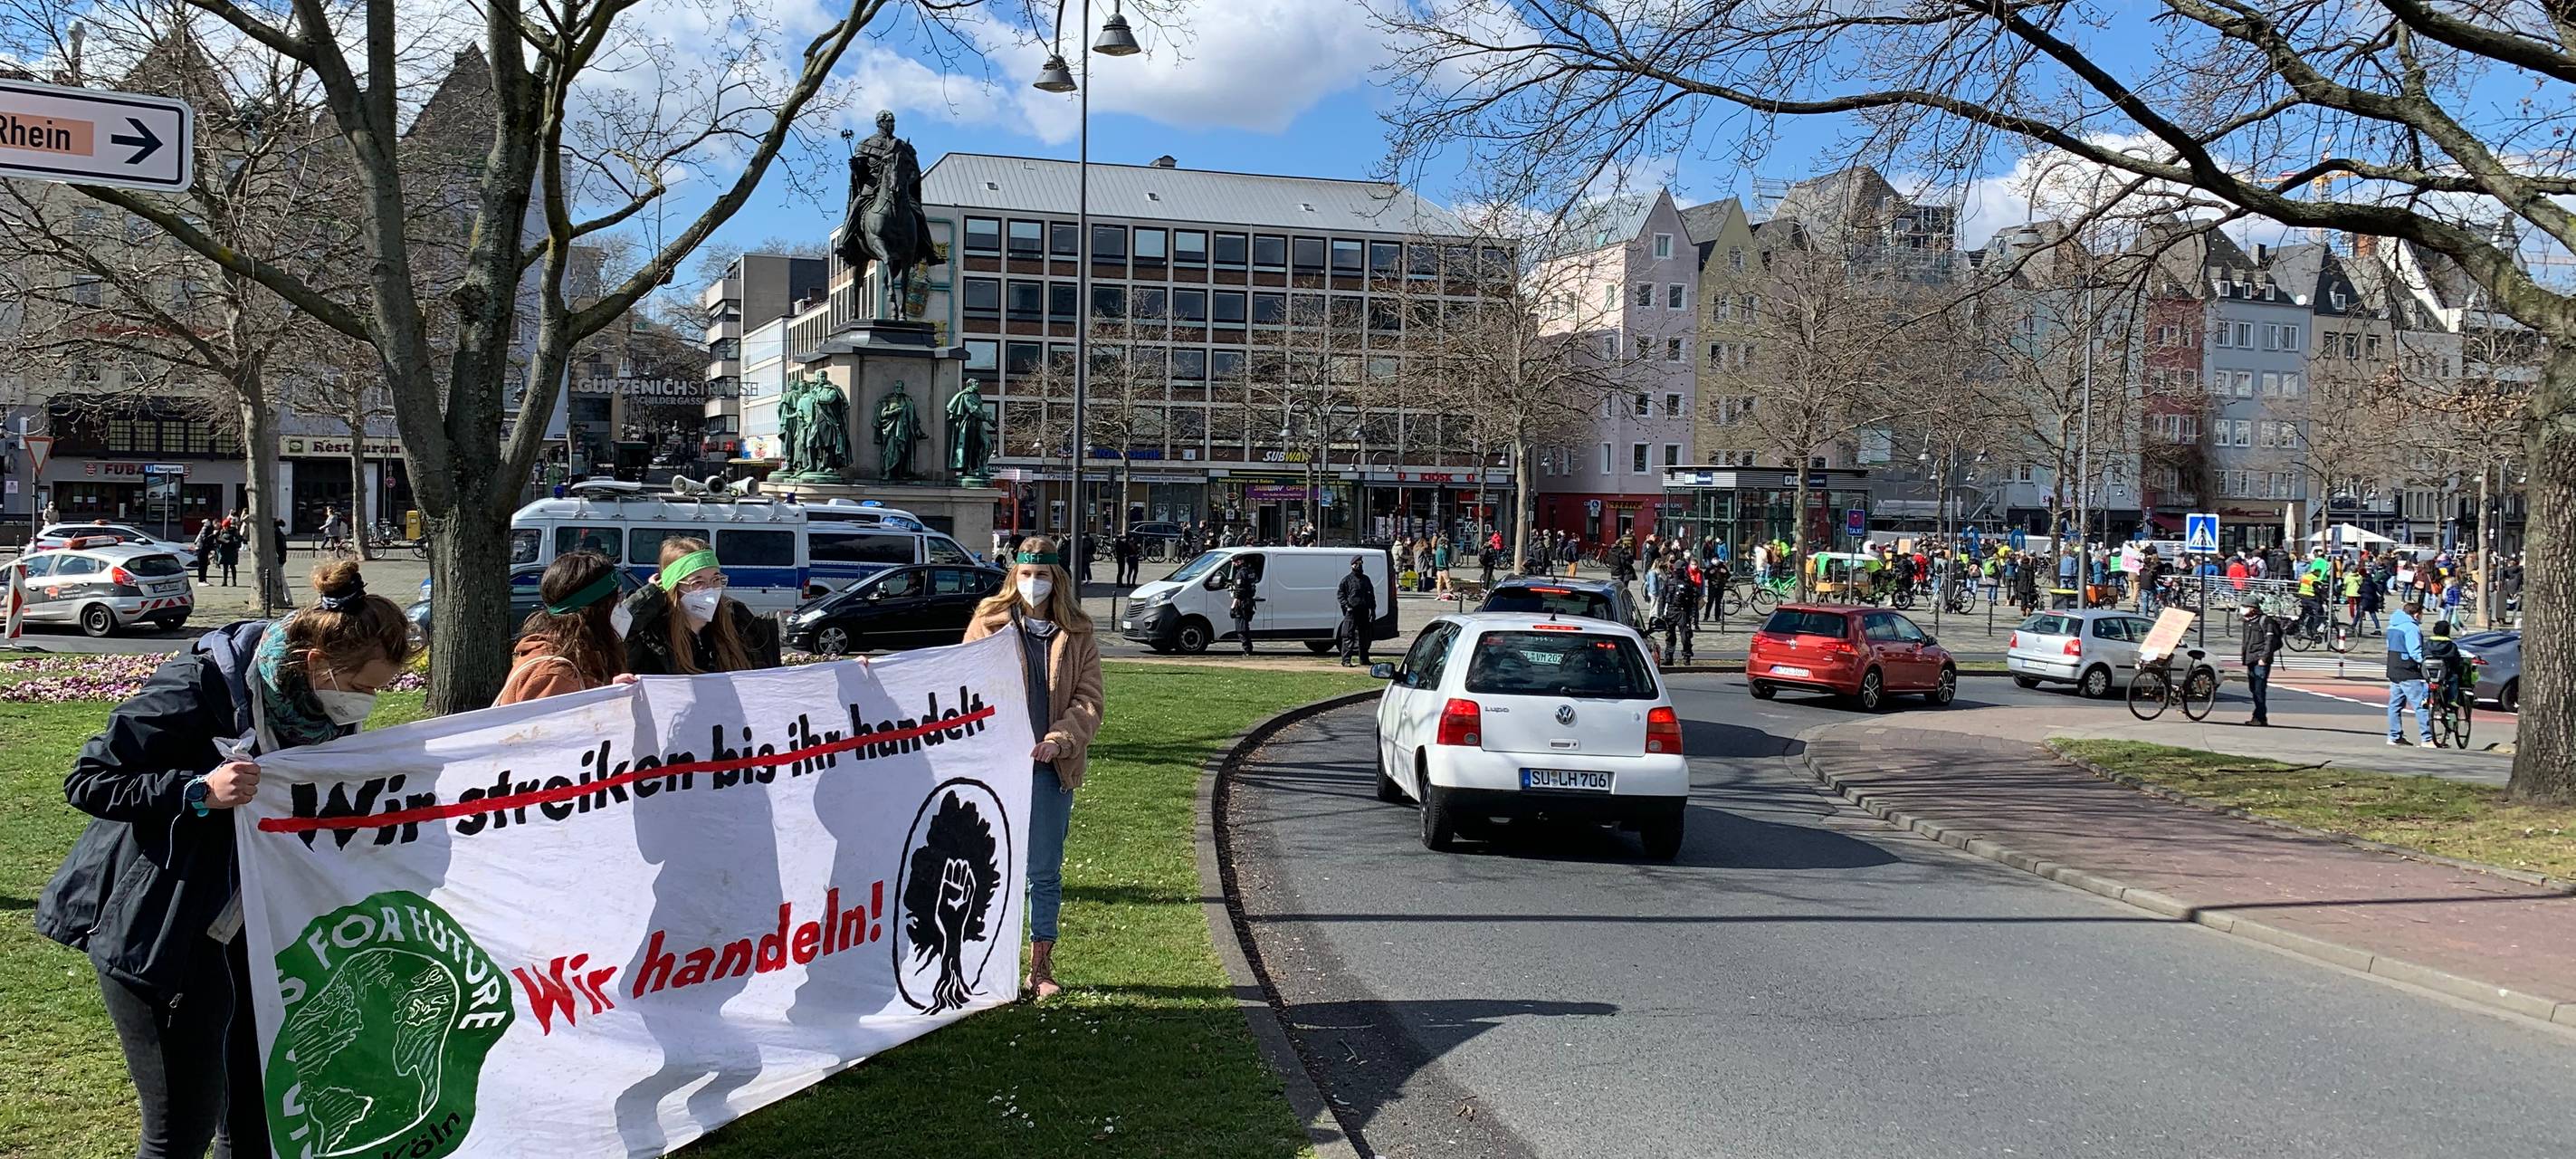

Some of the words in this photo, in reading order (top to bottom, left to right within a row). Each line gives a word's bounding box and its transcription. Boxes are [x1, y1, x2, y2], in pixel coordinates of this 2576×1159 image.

[0, 114, 71, 150] Rhein
[1420, 473, 1453, 482] KIOSK
[291, 774, 436, 852] Wir
[455, 740, 694, 836] streiken
[711, 724, 776, 790] bis
[788, 714, 842, 777] ihr
[850, 685, 986, 761] handelt
[1531, 771, 1550, 786] SU
[1559, 771, 1577, 786] LH
[1579, 773, 1607, 788] 706
[405, 905, 507, 1030] FUTURE
[510, 953, 618, 1036] Wir
[633, 880, 884, 1000] handeln!
